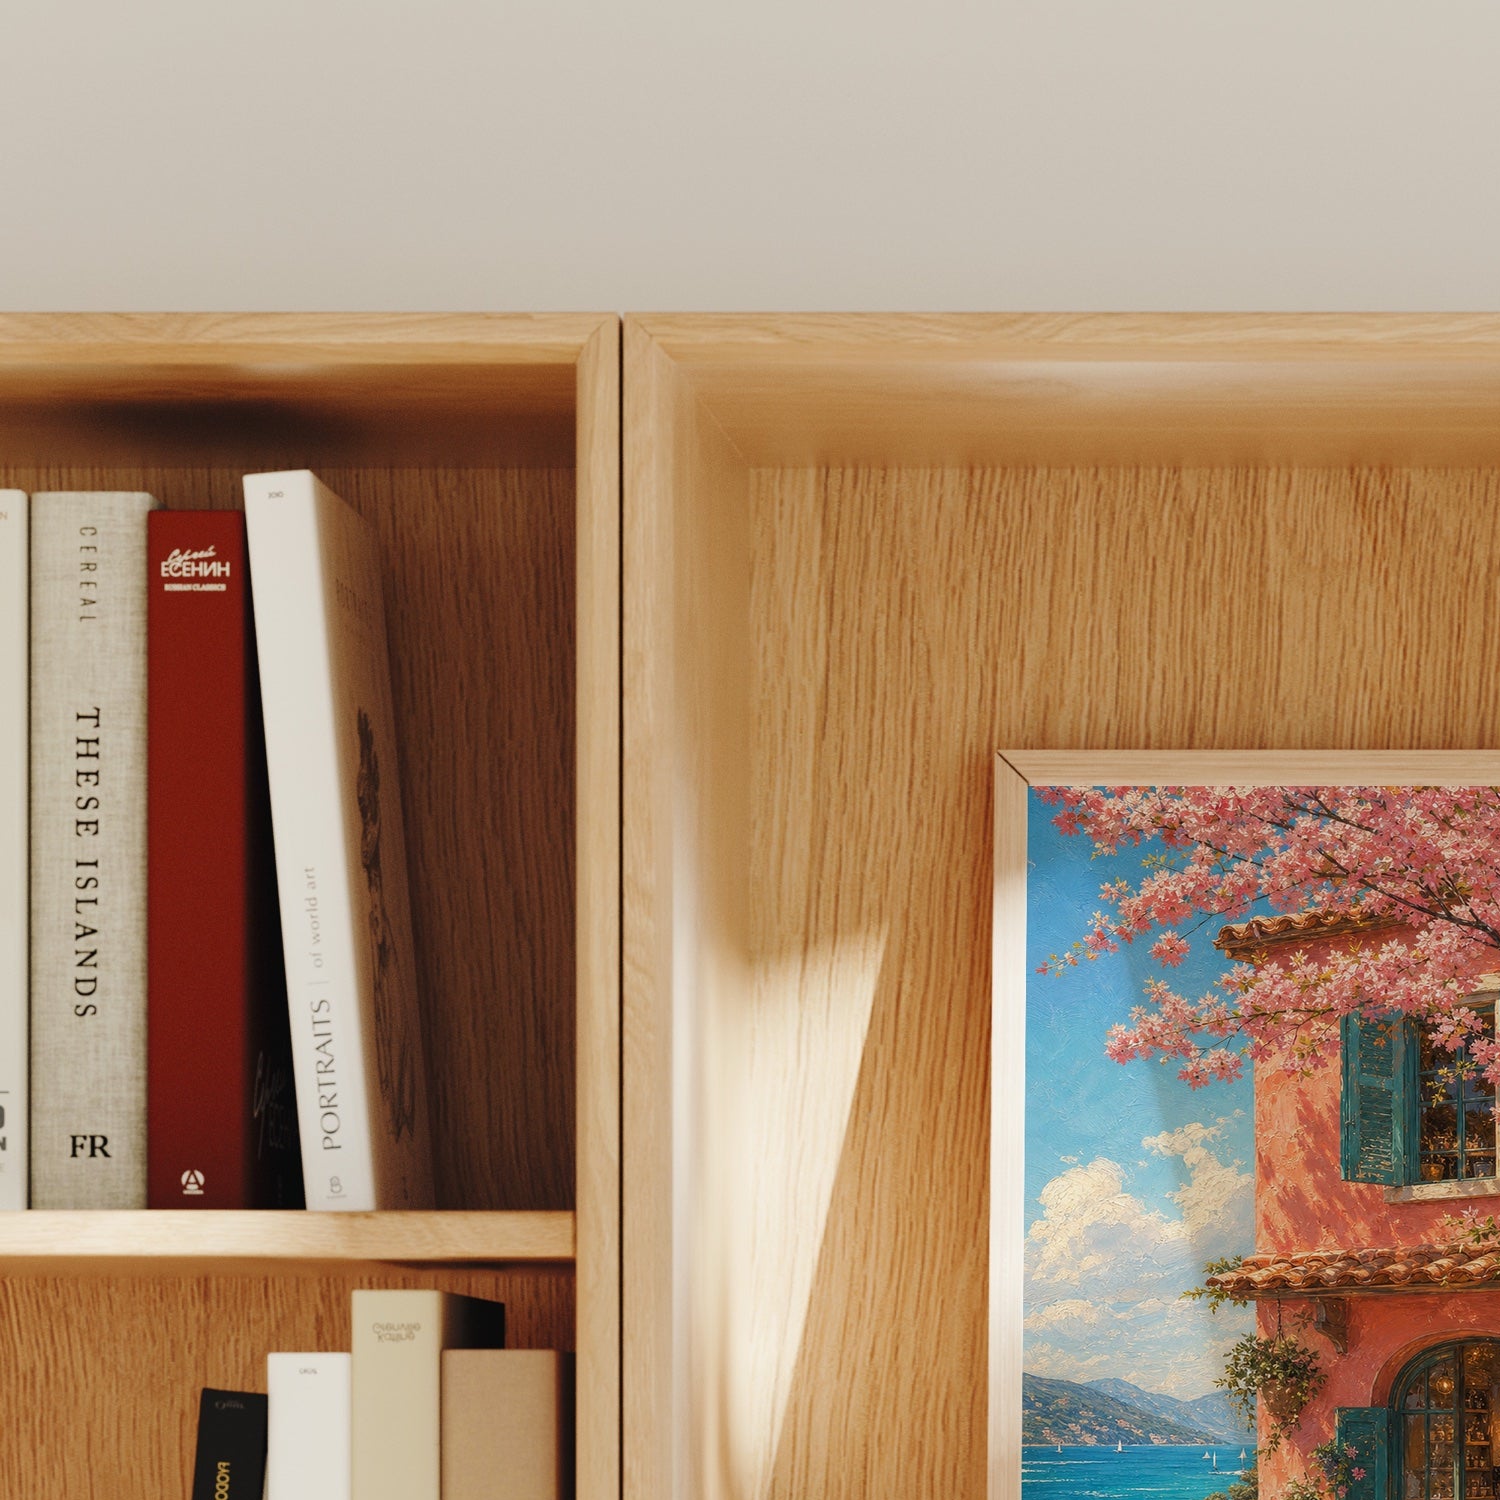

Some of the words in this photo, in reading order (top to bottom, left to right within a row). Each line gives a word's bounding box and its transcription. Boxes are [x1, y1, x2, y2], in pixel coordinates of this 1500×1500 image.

[79, 526, 98, 623] CEREAL
[161, 561, 231, 577] ЕСЕНИН
[75, 707, 100, 838] THESE
[304, 867, 316, 890] art
[74, 859, 99, 1018] ISLANDS
[304, 896, 320, 946] world
[313, 951, 324, 968] of
[310, 999, 342, 1151] PORTRAITS
[70, 1135, 111, 1158] FR
